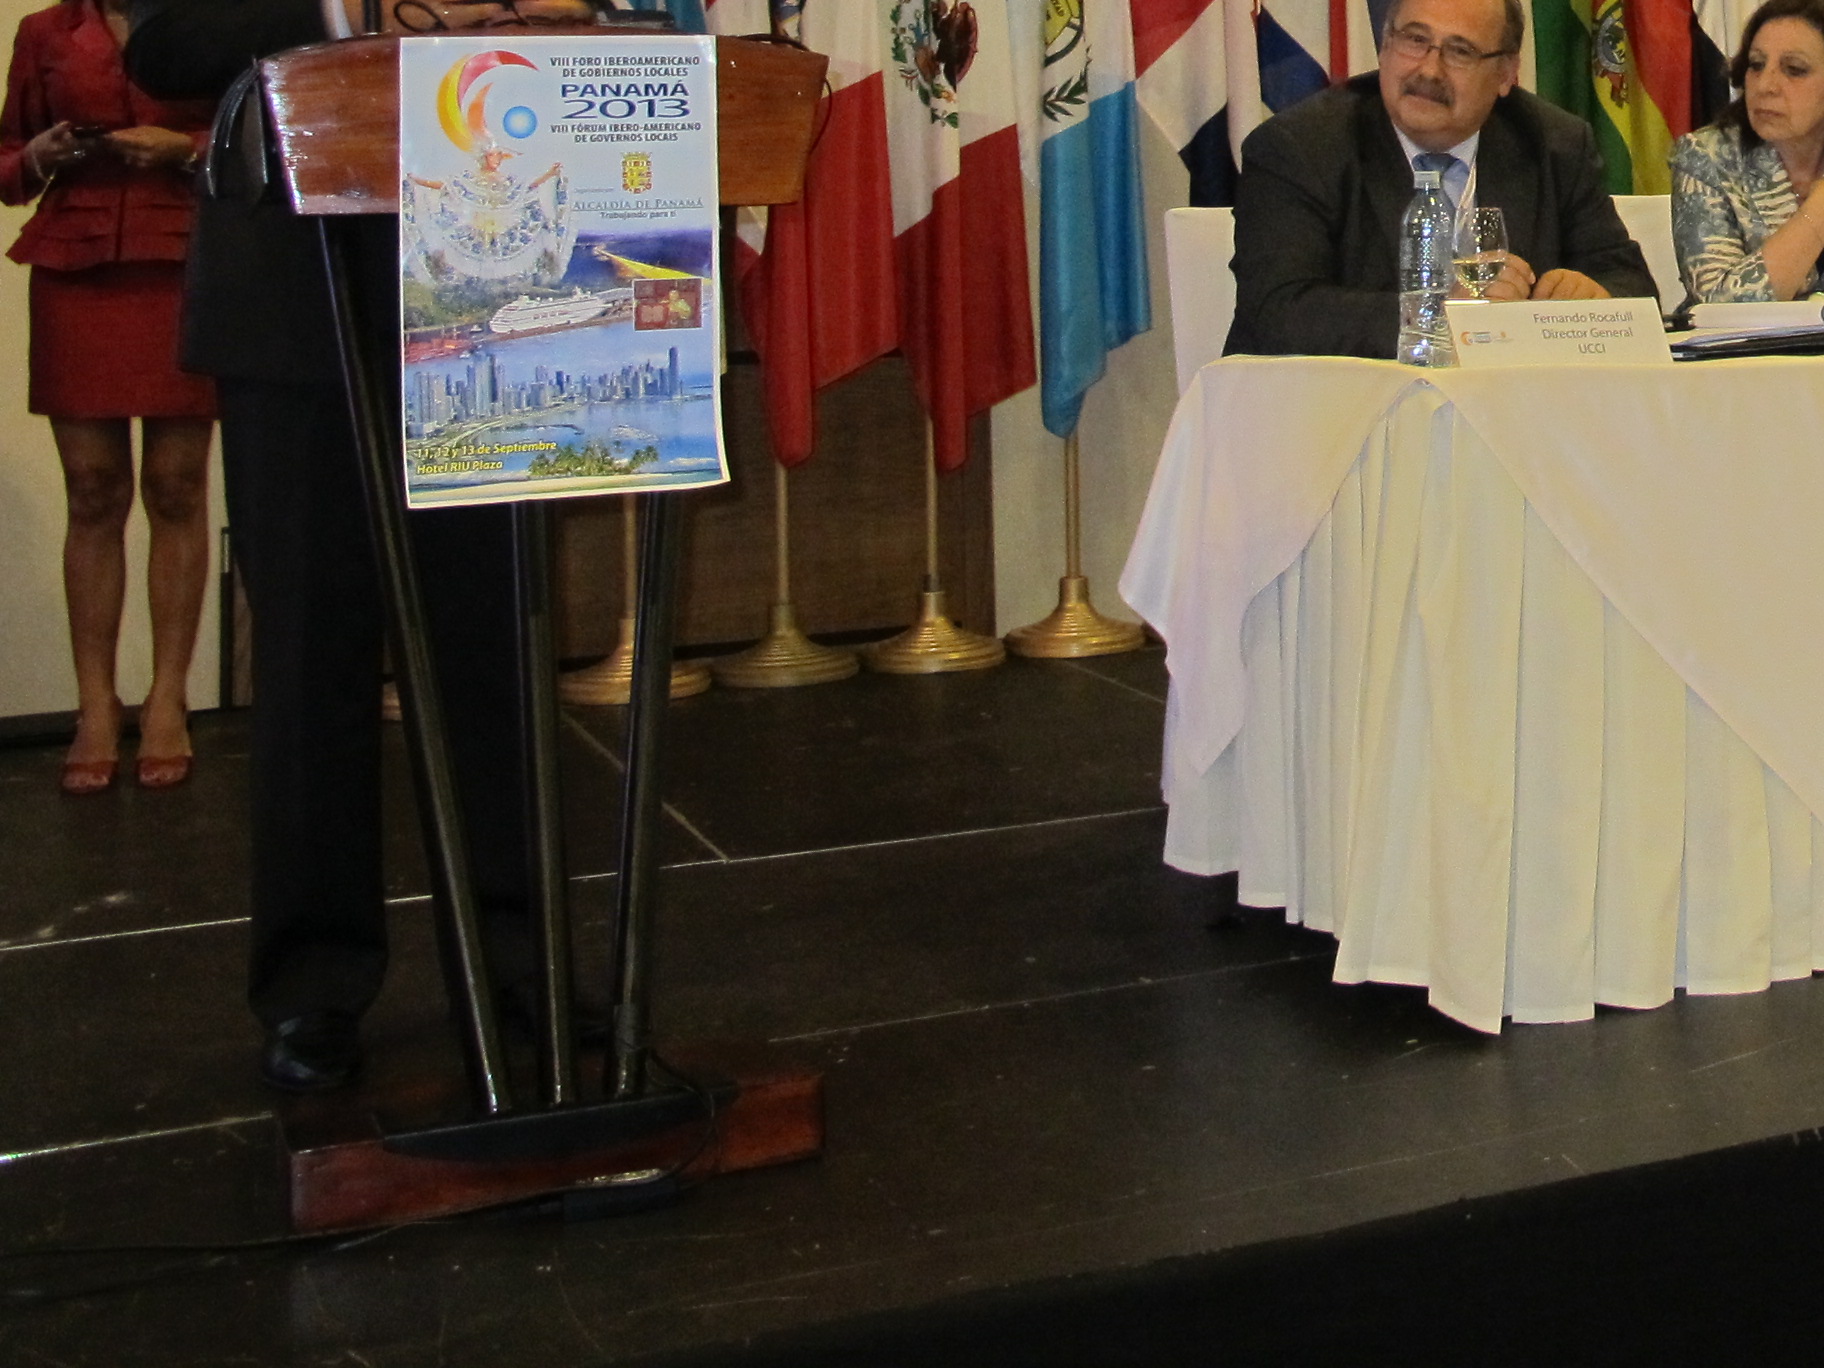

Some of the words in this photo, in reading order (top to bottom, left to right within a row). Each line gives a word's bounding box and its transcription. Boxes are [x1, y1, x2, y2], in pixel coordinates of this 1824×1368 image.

[550, 57, 570, 66] VIII
[572, 56, 601, 66] FORO
[604, 56, 700, 66] IBEROAMERICANO
[562, 68, 576, 78] DE
[579, 67, 642, 77] GOBIERNOS
[644, 67, 688, 77] LOCALES
[561, 80, 689, 98] PANAMÁ
[561, 98, 691, 119] 2013
[550, 124, 569, 133] VIII
[571, 123, 607, 133] FÓRUM
[609, 122, 701, 133] IBERO-AMERICANO
[574, 134, 588, 143] DE
[590, 133, 643, 143] GOVERNOS
[645, 132, 678, 142] LOCAIS
[1533, 312, 1587, 324] Fernando
[1589, 311, 1633, 323] Rocafull
[1542, 329, 1589, 340] Director
[1590, 327, 1633, 338] General
[1578, 343, 1606, 354] UCCI
[462, 445, 475, 456] 13
[476, 443, 491, 454] de
[493, 440, 557, 455] Septiembre
[417, 463, 448, 474] Hotel
[450, 461, 470, 472] RIU
[472, 459, 503, 471] Plaza
